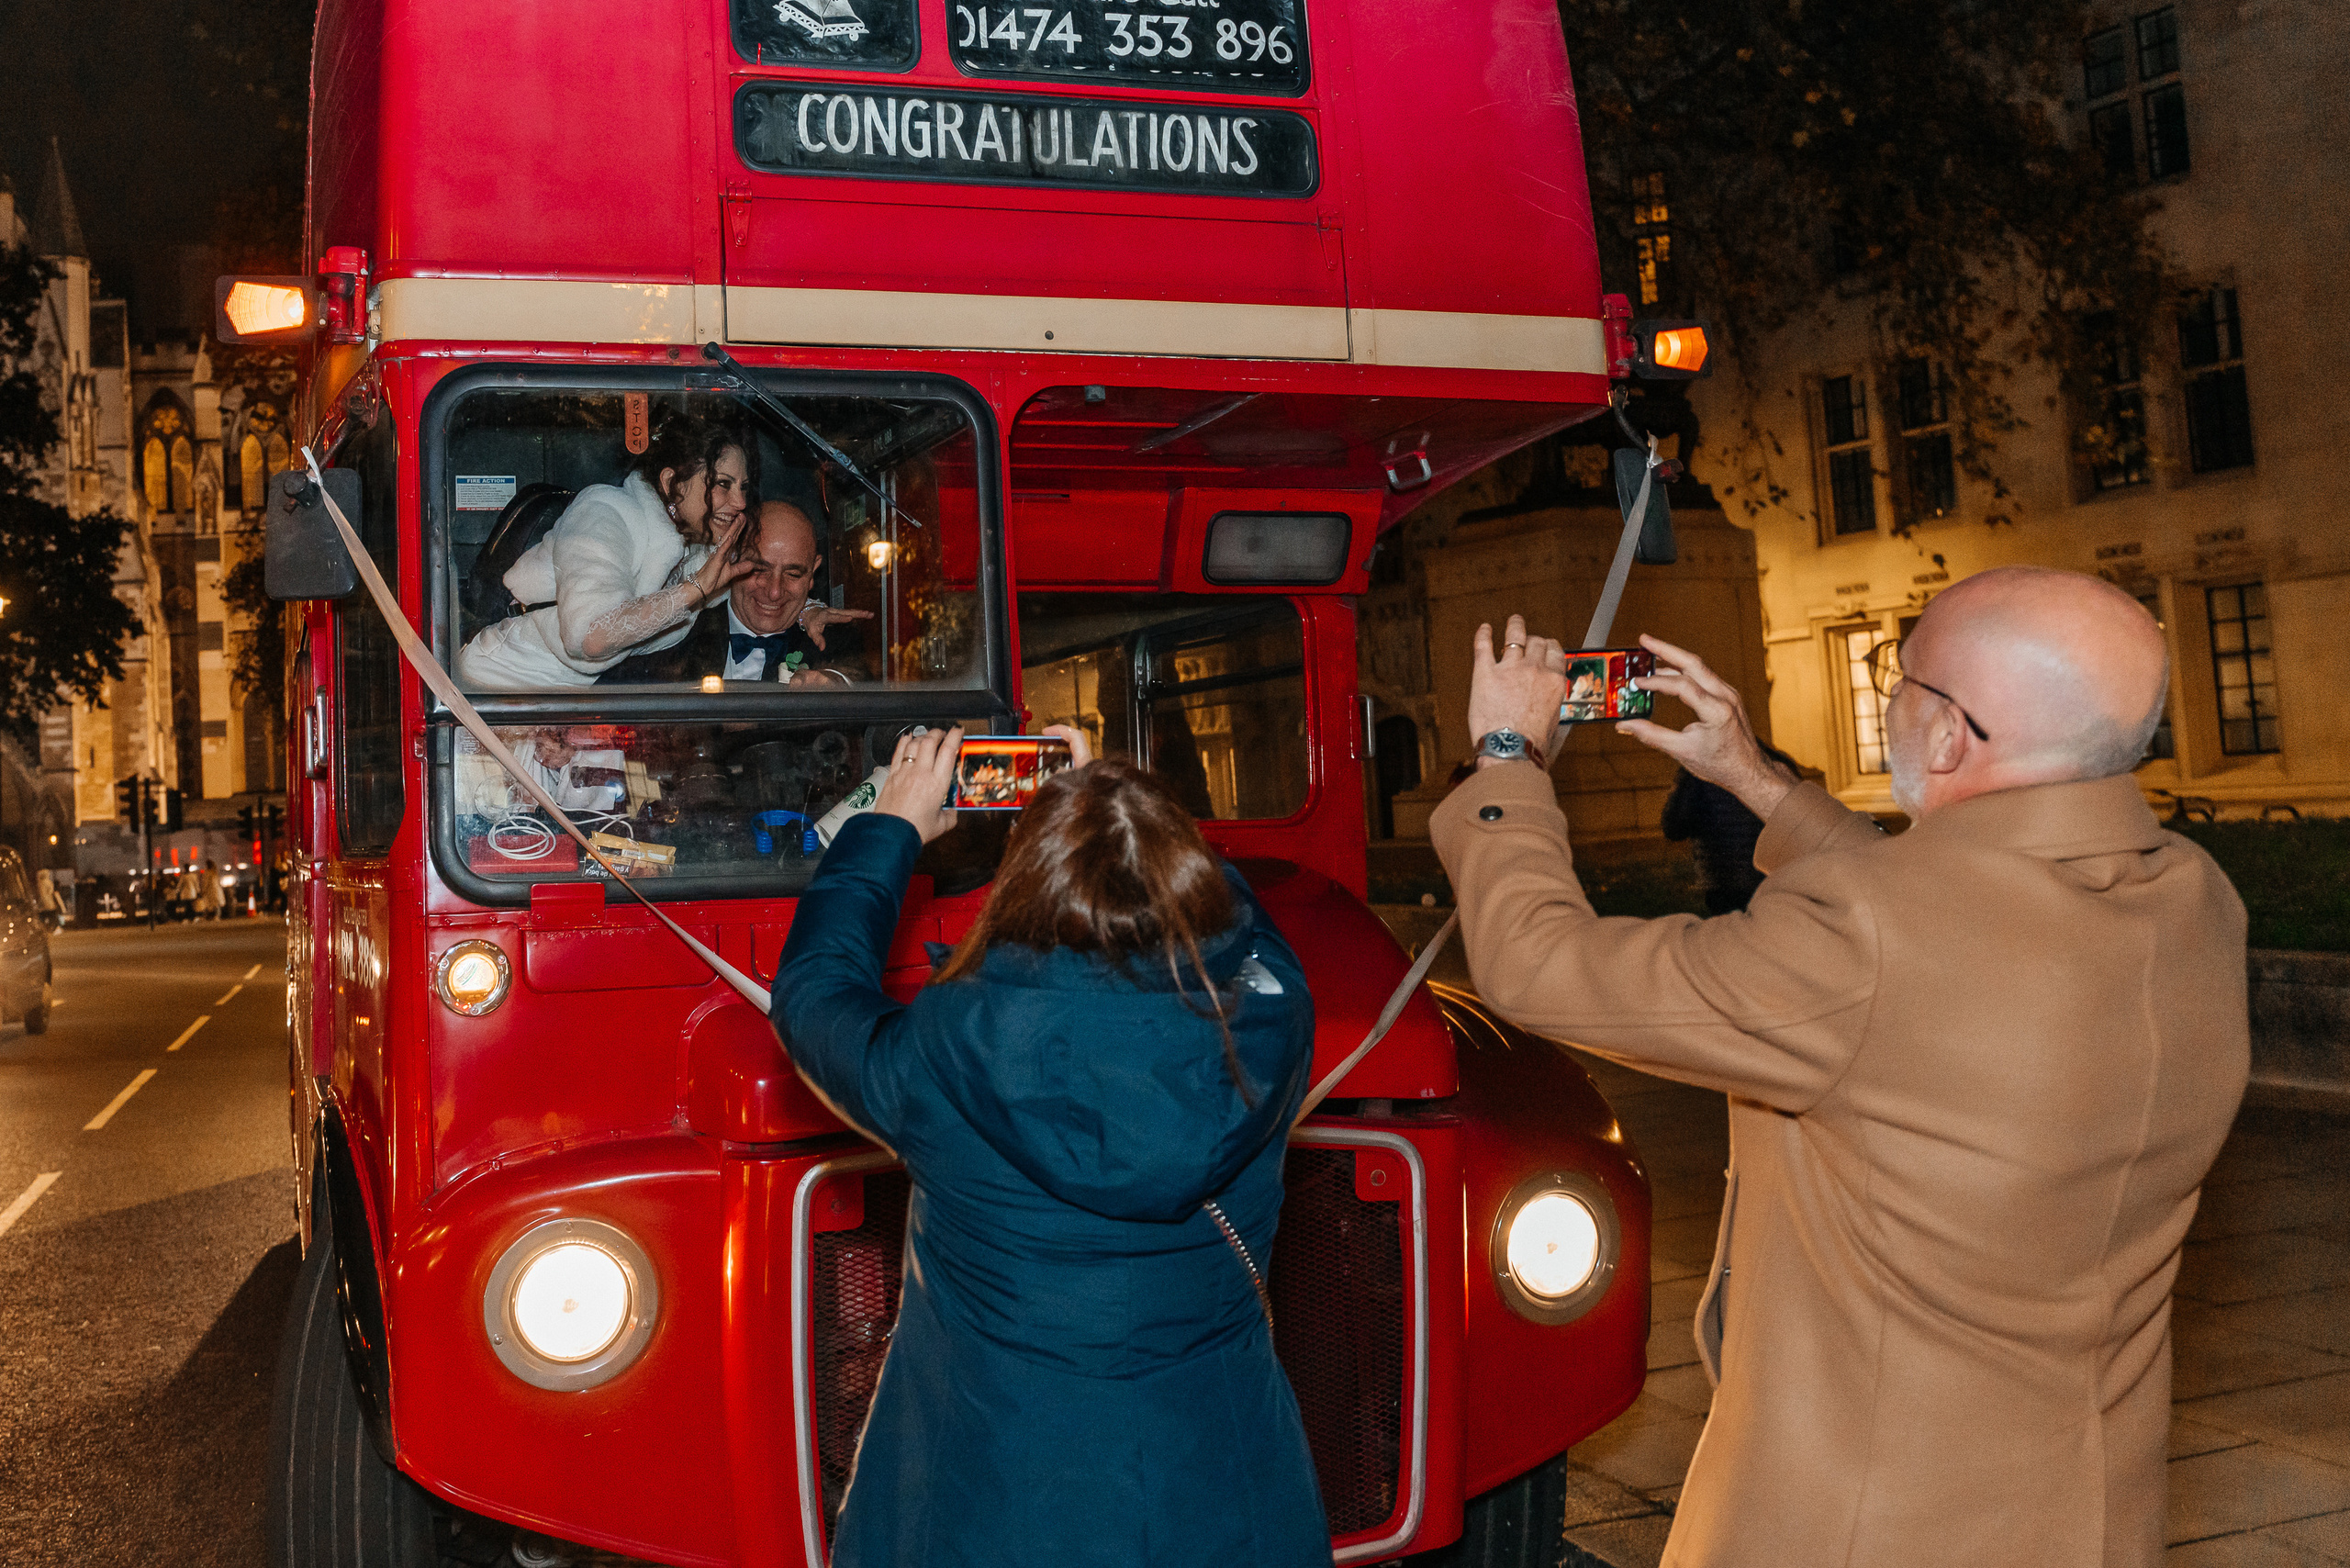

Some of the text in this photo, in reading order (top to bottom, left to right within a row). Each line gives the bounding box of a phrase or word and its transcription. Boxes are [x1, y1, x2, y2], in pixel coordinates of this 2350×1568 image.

[1104, 12, 1192, 58] 353
[1215, 18, 1293, 64] 896
[798, 93, 1259, 175] CONGRATULATIONS
